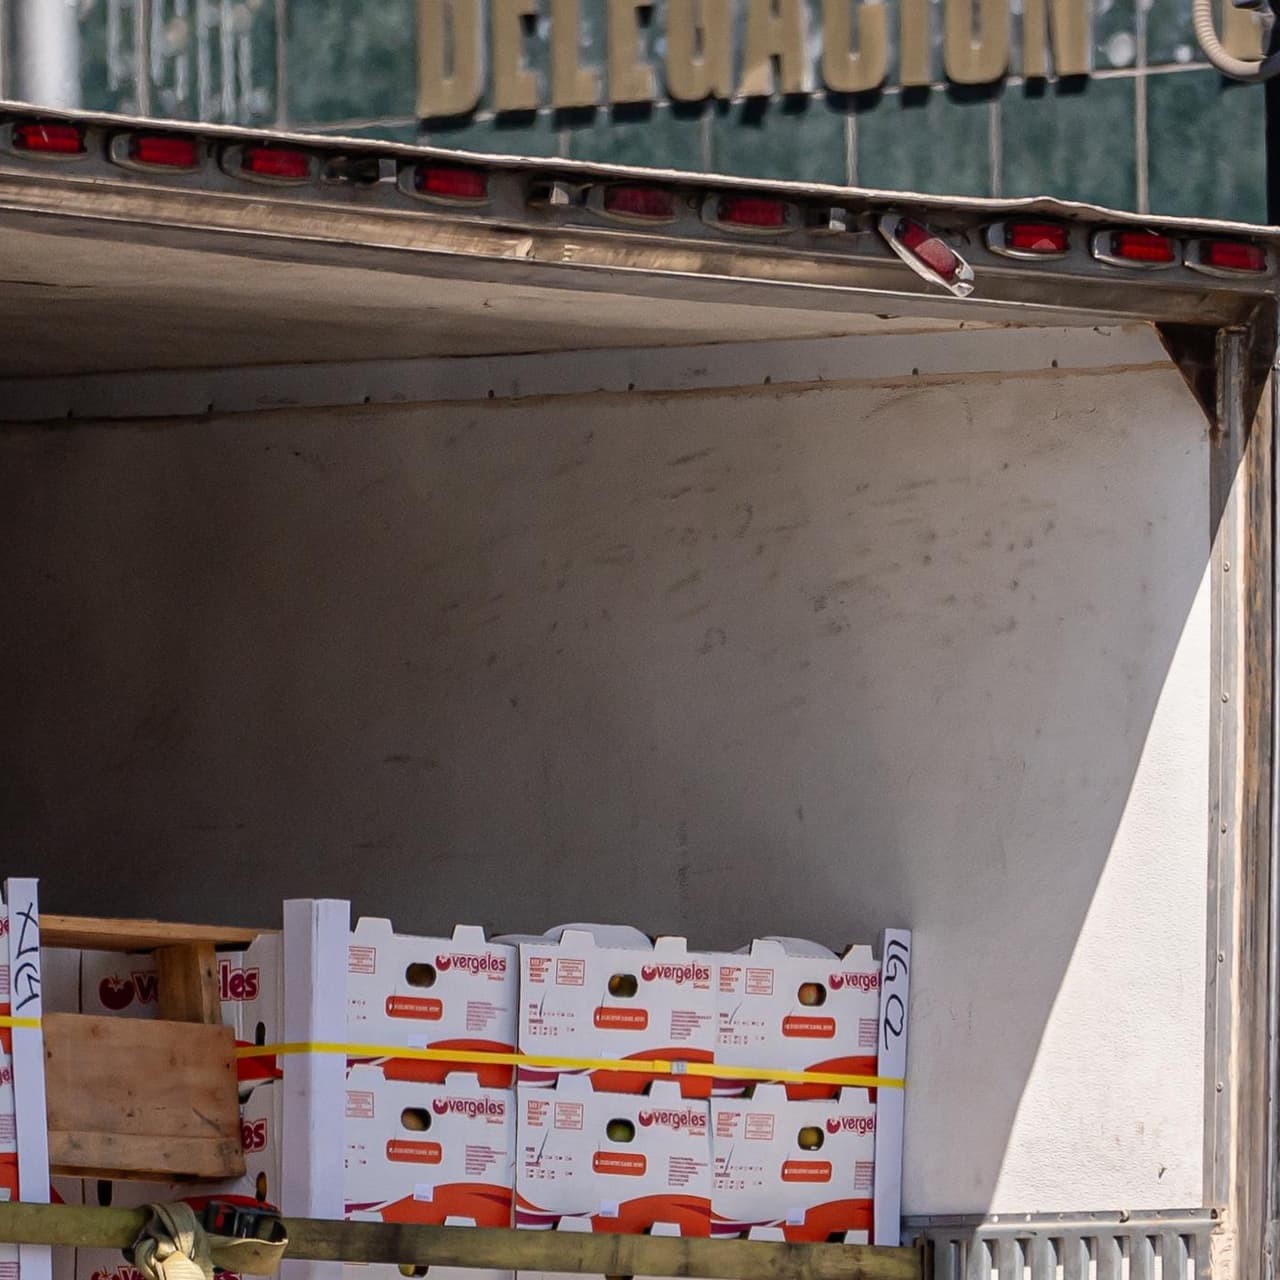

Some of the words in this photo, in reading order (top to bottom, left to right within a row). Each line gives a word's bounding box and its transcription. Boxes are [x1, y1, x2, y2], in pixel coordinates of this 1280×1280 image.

[451, 952, 506, 974] vergeles
[656, 962, 711, 984] vergeles
[450, 1096, 504, 1119] vergeles
[653, 1108, 706, 1129] vergeles
